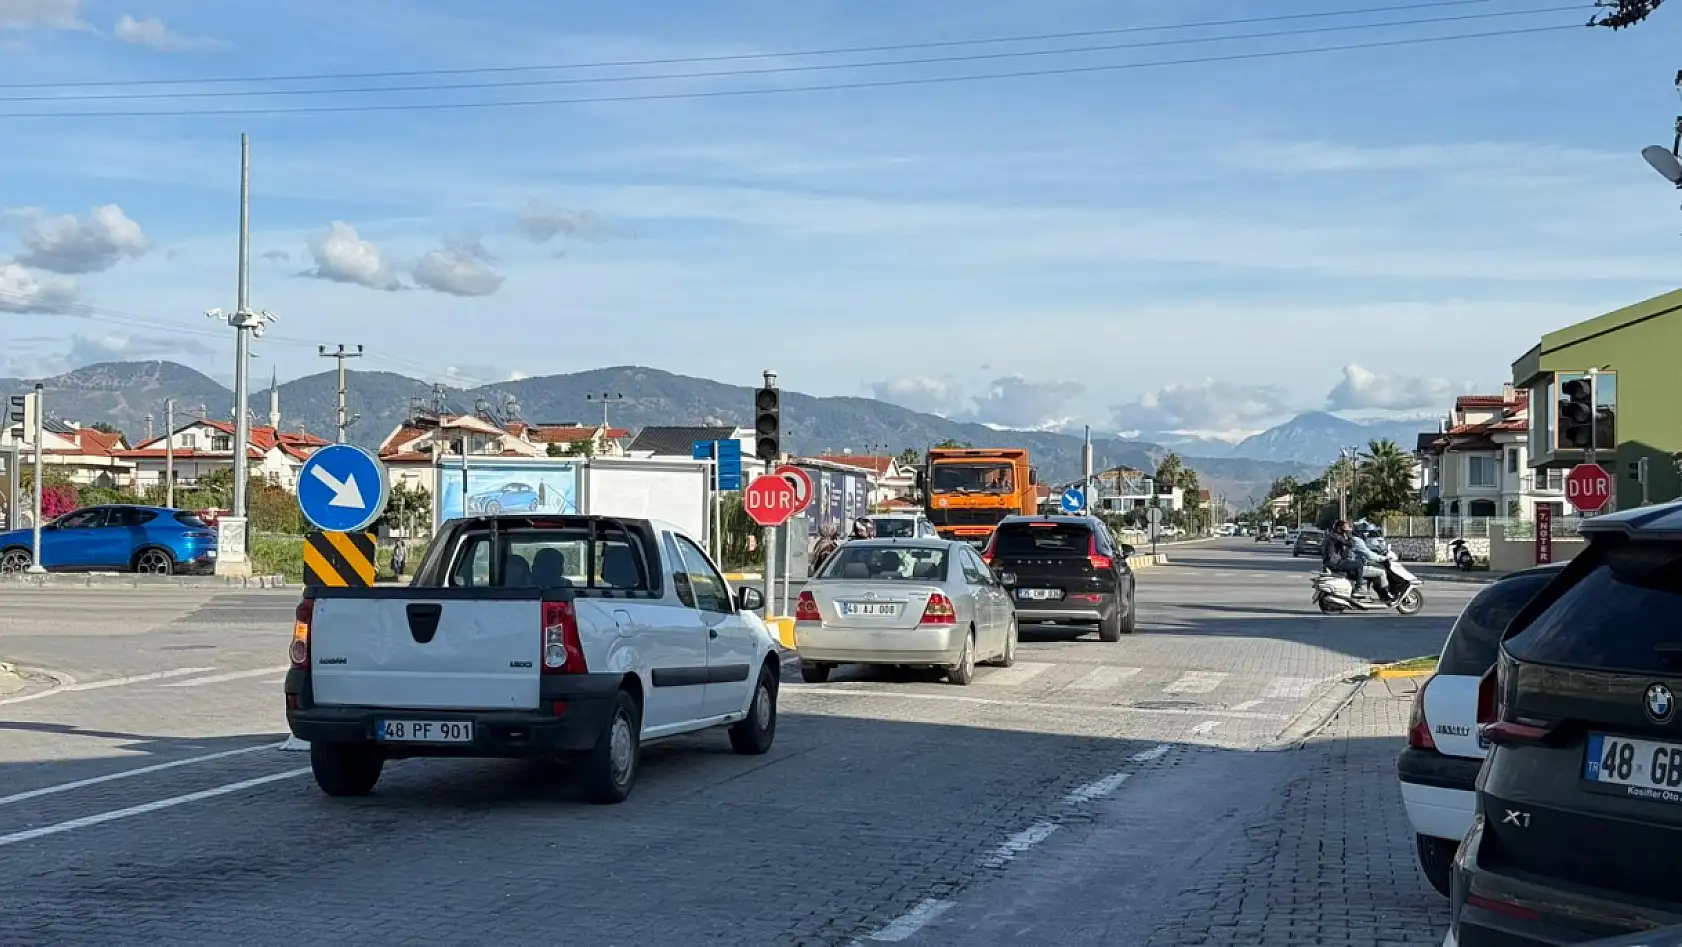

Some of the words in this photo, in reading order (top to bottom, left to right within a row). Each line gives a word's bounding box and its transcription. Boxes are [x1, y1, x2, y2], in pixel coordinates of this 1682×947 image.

[1569, 478, 1607, 497] DUR
[749, 490, 791, 509] DUR
[386, 722, 404, 738] 48
[412, 723, 433, 739] PF
[440, 723, 469, 739] 901
[1602, 741, 1635, 781] 48
[1650, 747, 1682, 787] GB
[1501, 808, 1530, 828] X1
